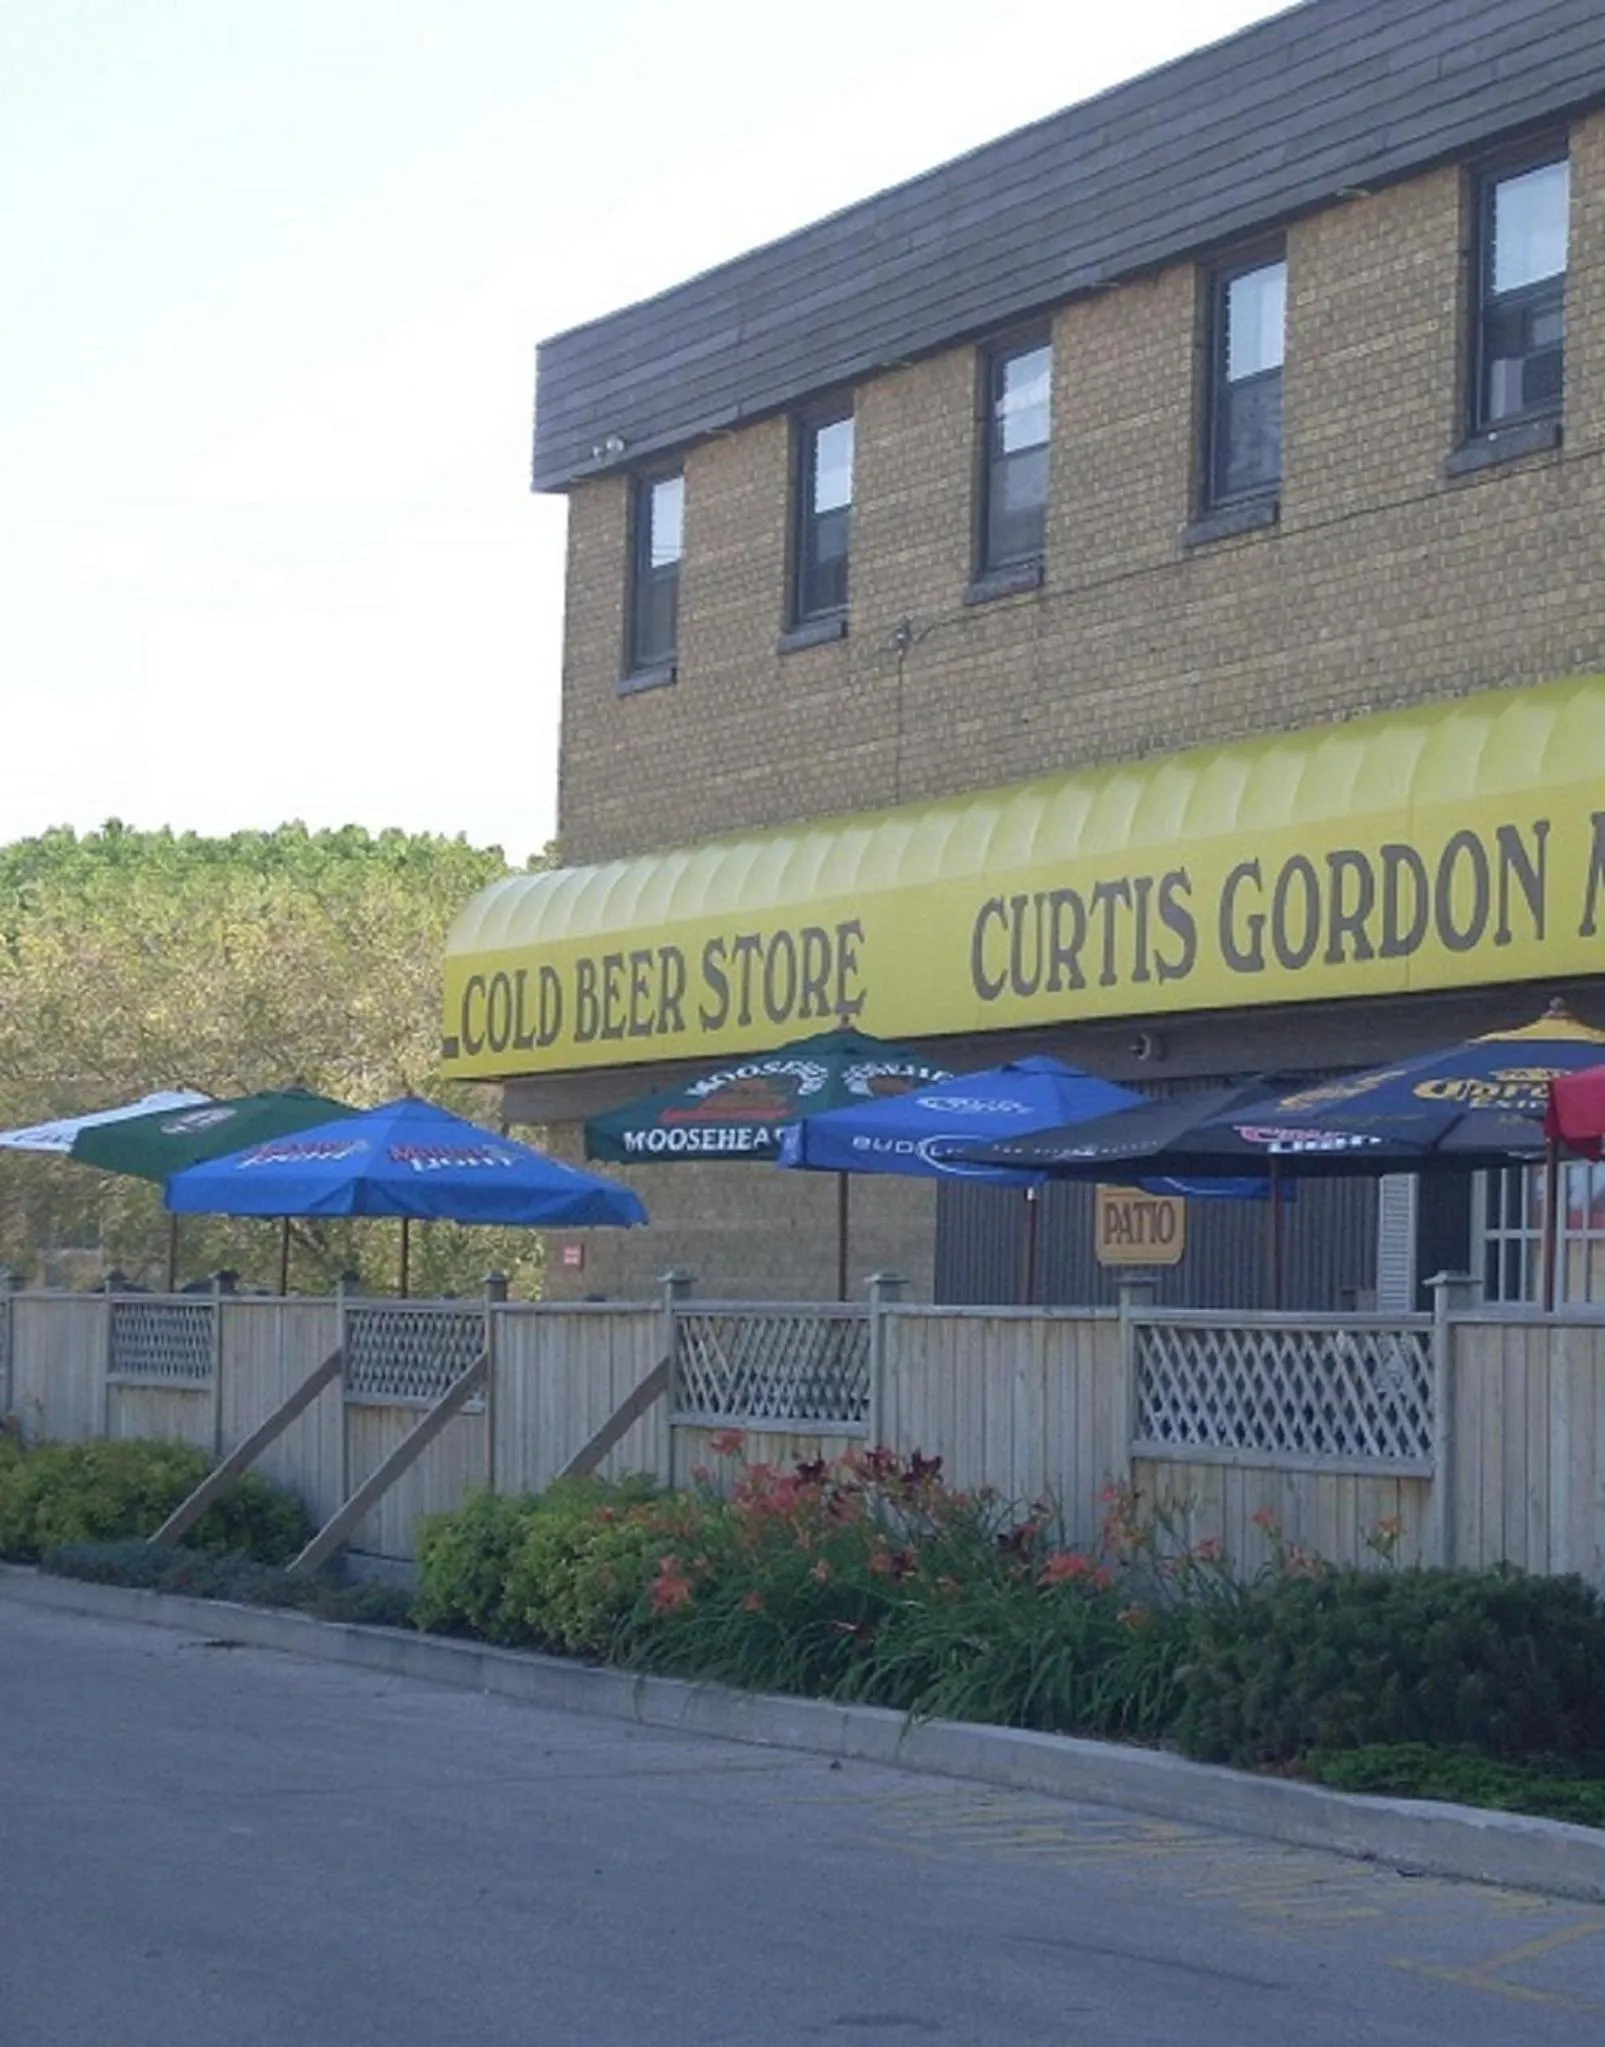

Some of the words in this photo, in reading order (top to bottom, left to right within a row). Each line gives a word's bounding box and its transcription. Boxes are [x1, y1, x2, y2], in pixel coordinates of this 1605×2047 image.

[970, 865, 1199, 1001] CURTIS
[1218, 819, 1551, 973] GORDON
[461, 965, 563, 1056] COLD
[573, 945, 687, 1043] BEER
[699, 918, 868, 1033] STORE
[1103, 1200, 1176, 1246] PATIO
